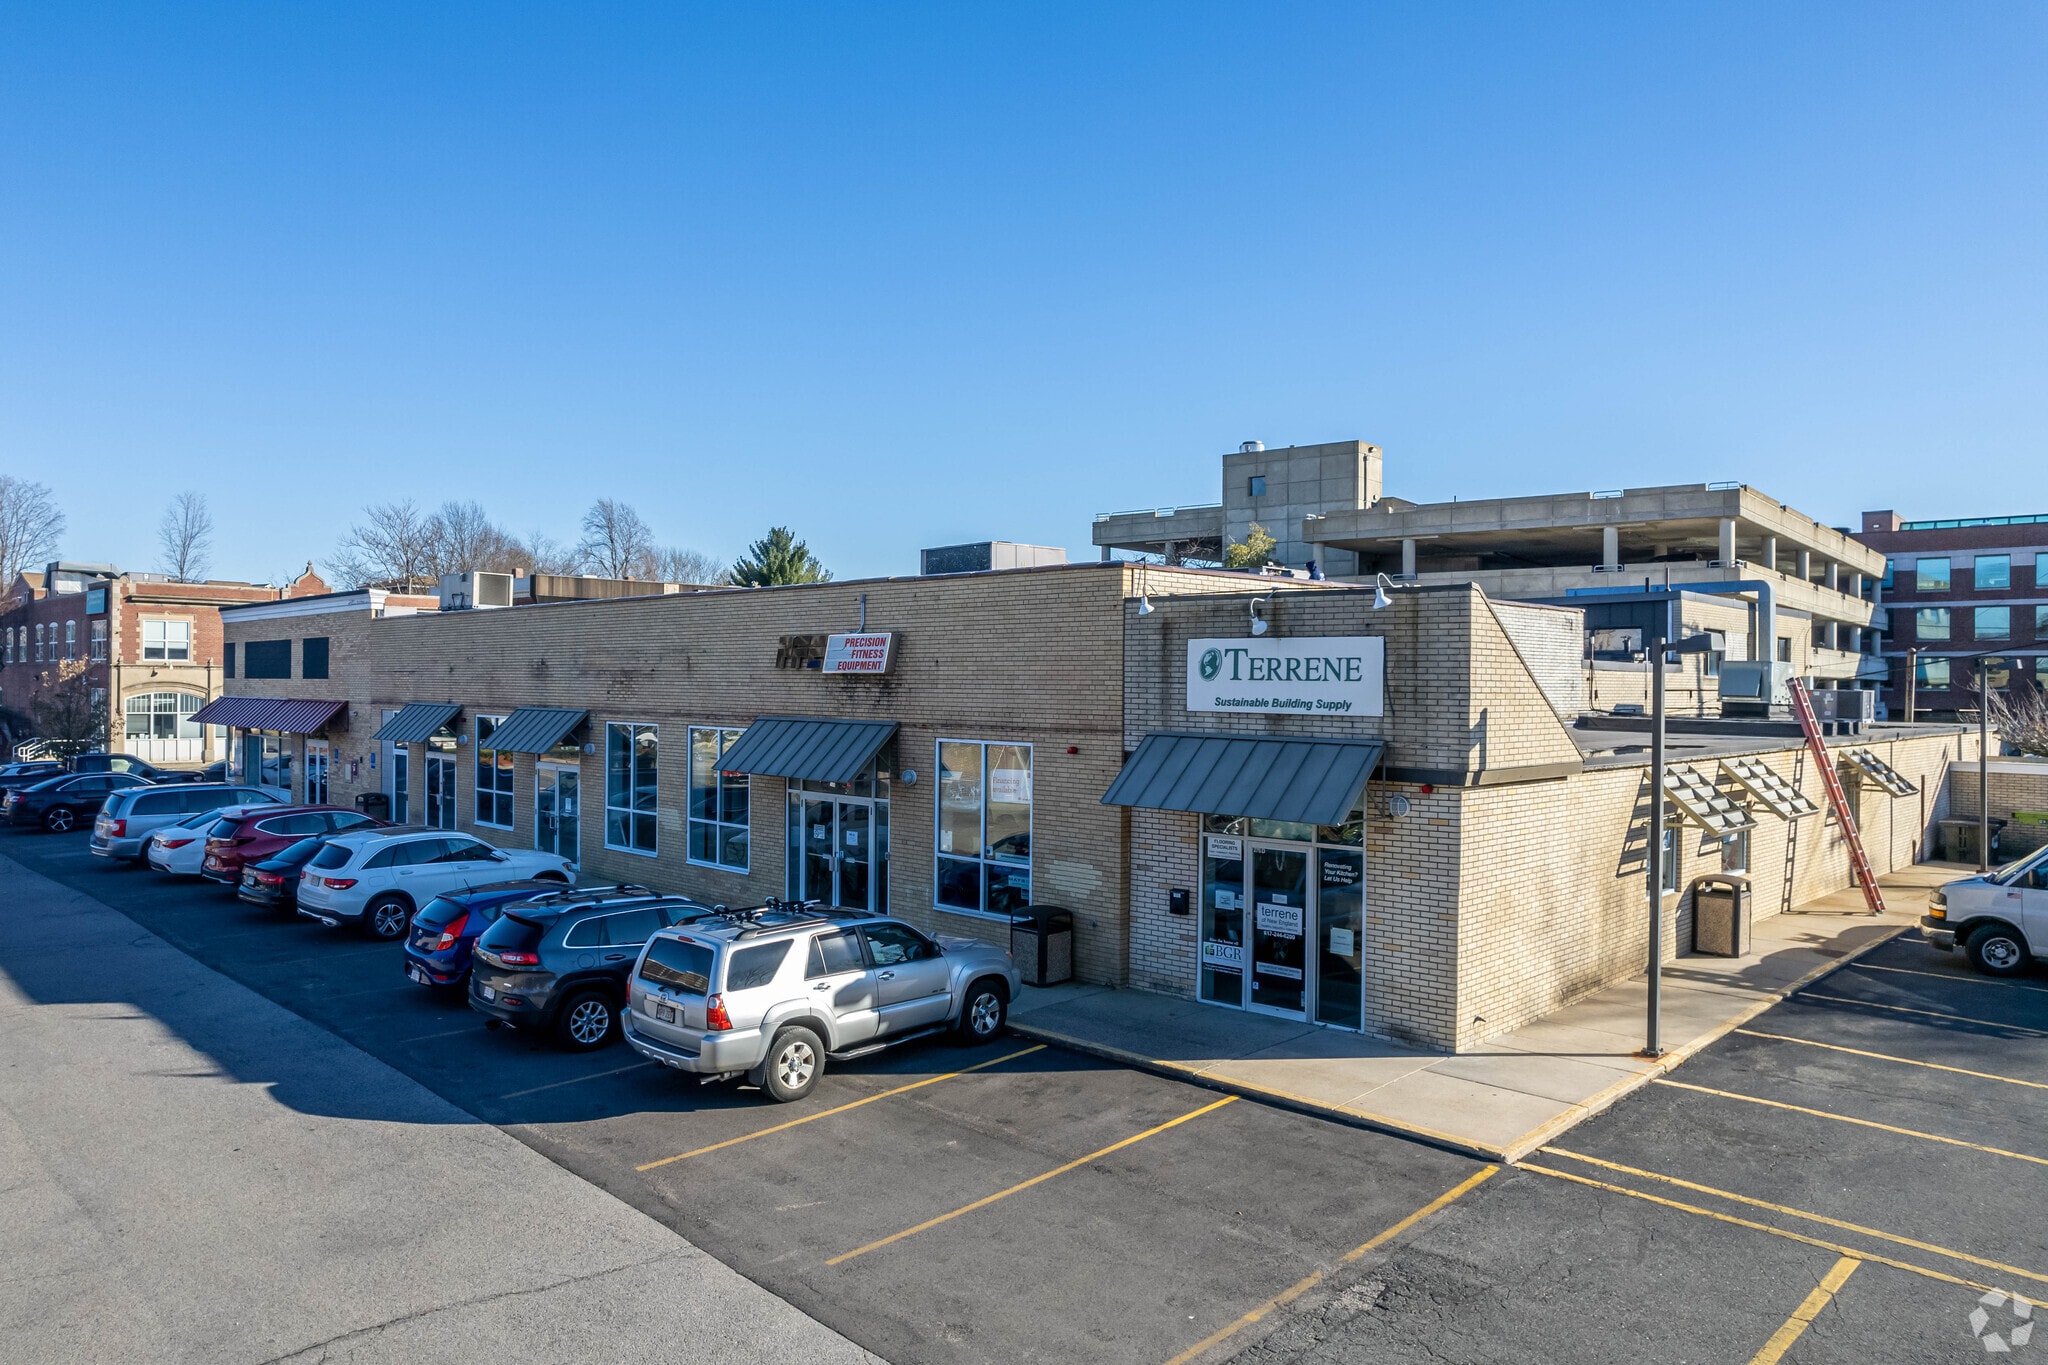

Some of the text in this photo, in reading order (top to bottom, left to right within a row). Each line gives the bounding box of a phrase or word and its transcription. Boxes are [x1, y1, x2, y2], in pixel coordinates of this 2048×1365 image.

[844, 637, 886, 648] PRECISION
[851, 649, 884, 659] FITNESS
[837, 661, 882, 671] EQUIPMENT
[1224, 647, 1363, 682] TERRENE
[1214, 697, 1352, 712] Sustainable Building Supply
[1324, 861, 1352, 871] Renovating
[1261, 905, 1298, 921] terrene
[1278, 919, 1298, 928] England
[1215, 945, 1242, 961] BGR
